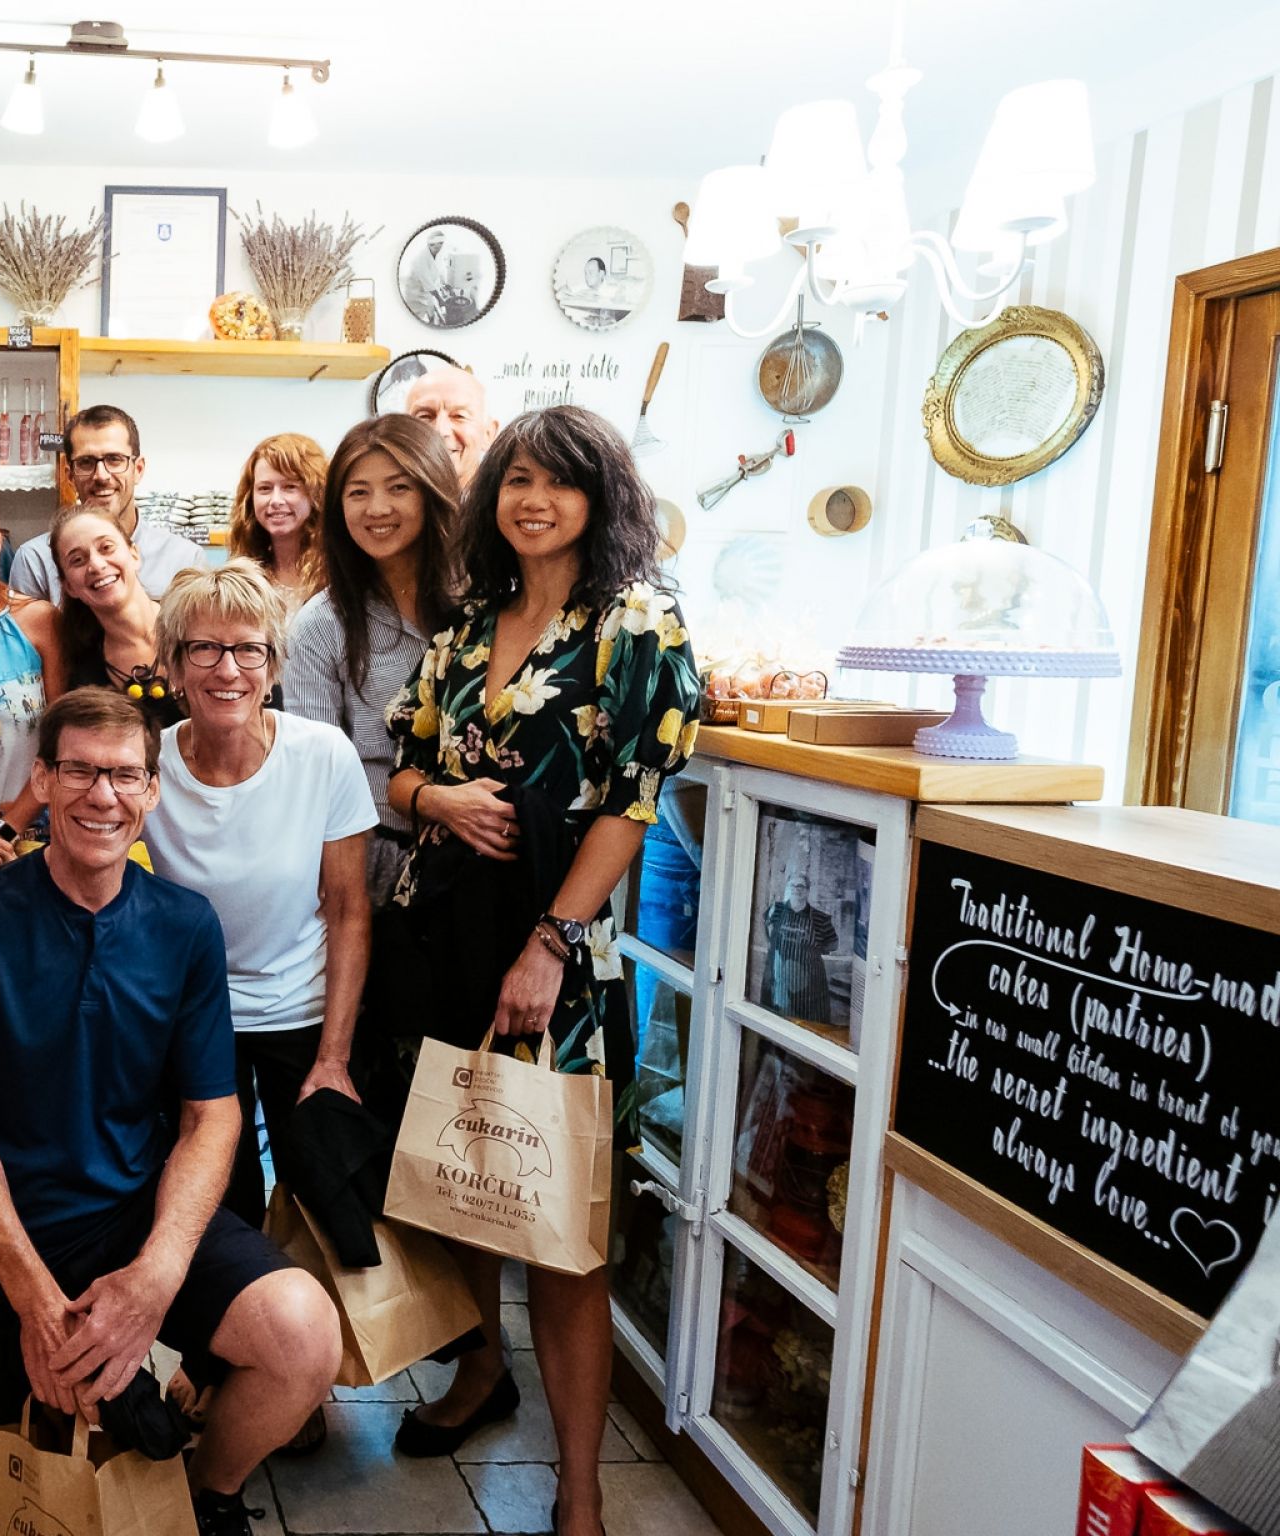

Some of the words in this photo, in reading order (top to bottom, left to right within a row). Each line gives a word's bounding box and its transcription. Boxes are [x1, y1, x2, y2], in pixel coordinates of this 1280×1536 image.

[950, 877, 1096, 960] Traditional
[985, 1017, 1008, 1042] our
[1016, 1030, 1061, 1062] small
[1066, 1043, 1121, 1090] kitchen
[1129, 1071, 1149, 1102] in
[988, 960, 1050, 1010] cakes
[1070, 981, 1212, 1083] (pastries)
[454, 1117, 540, 1148] cukarin
[990, 1067, 1068, 1121] secret
[1080, 1099, 1243, 1204] ingredient
[992, 1116, 1075, 1205] always
[435, 1162, 542, 1208] KORČULA
[449, 1205, 518, 1231] www.cukarin.hr
[462, 1193, 537, 1223] 020/711-055
